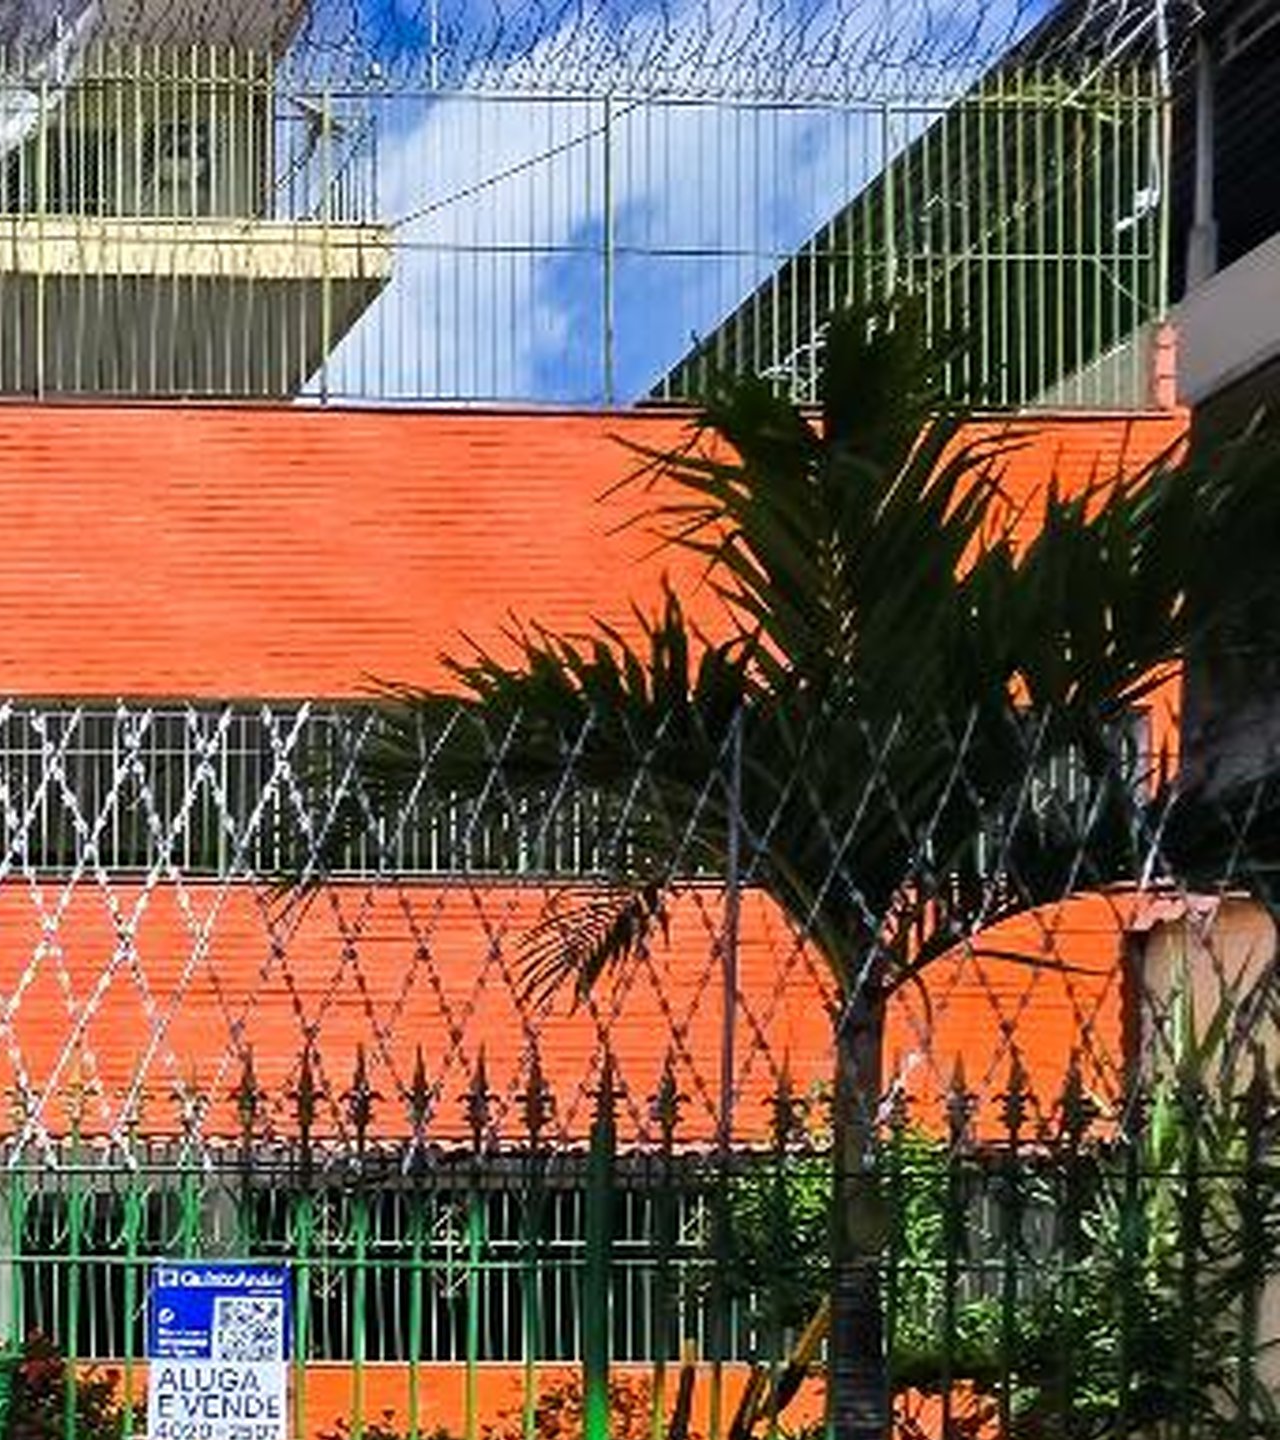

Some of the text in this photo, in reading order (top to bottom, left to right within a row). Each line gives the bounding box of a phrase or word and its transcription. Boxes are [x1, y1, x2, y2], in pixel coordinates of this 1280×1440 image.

[157, 1368, 261, 1392] ALUGA
[157, 1394, 281, 1419] E VENDE
